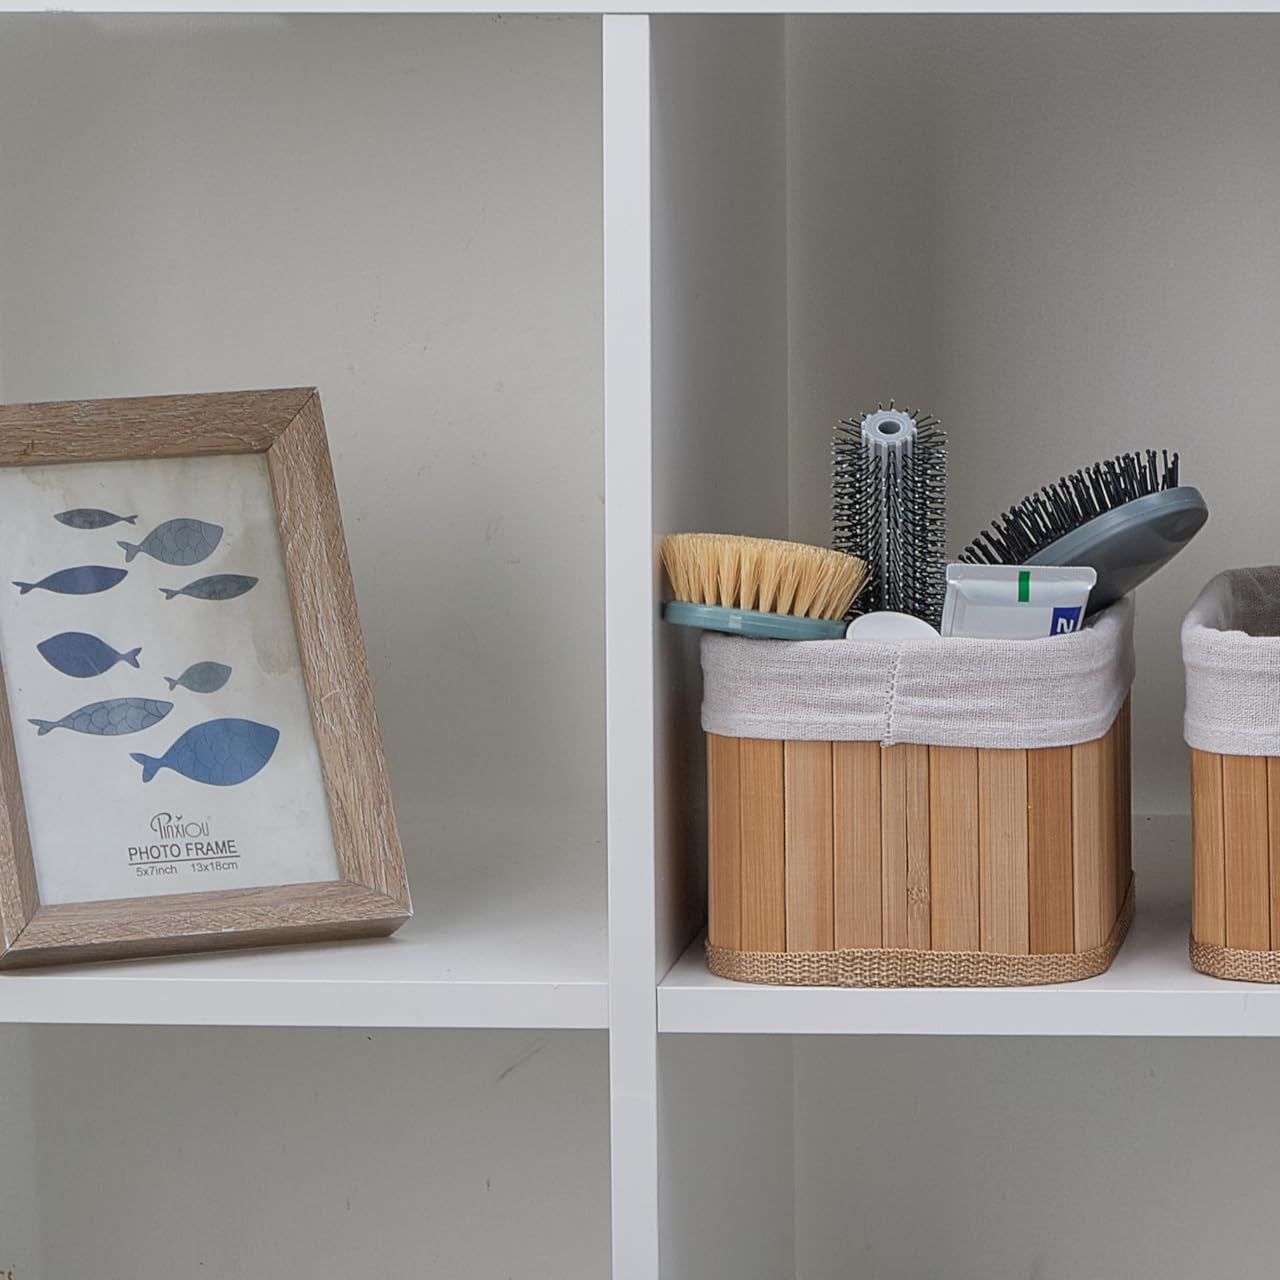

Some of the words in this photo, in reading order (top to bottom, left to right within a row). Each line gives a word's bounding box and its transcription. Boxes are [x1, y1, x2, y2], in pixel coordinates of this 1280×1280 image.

[128, 842, 181, 861] PHOTO
[185, 839, 238, 857] FRAME
[136, 864, 178, 877] 5x7inch
[190, 860, 239, 873] 13x18cm
